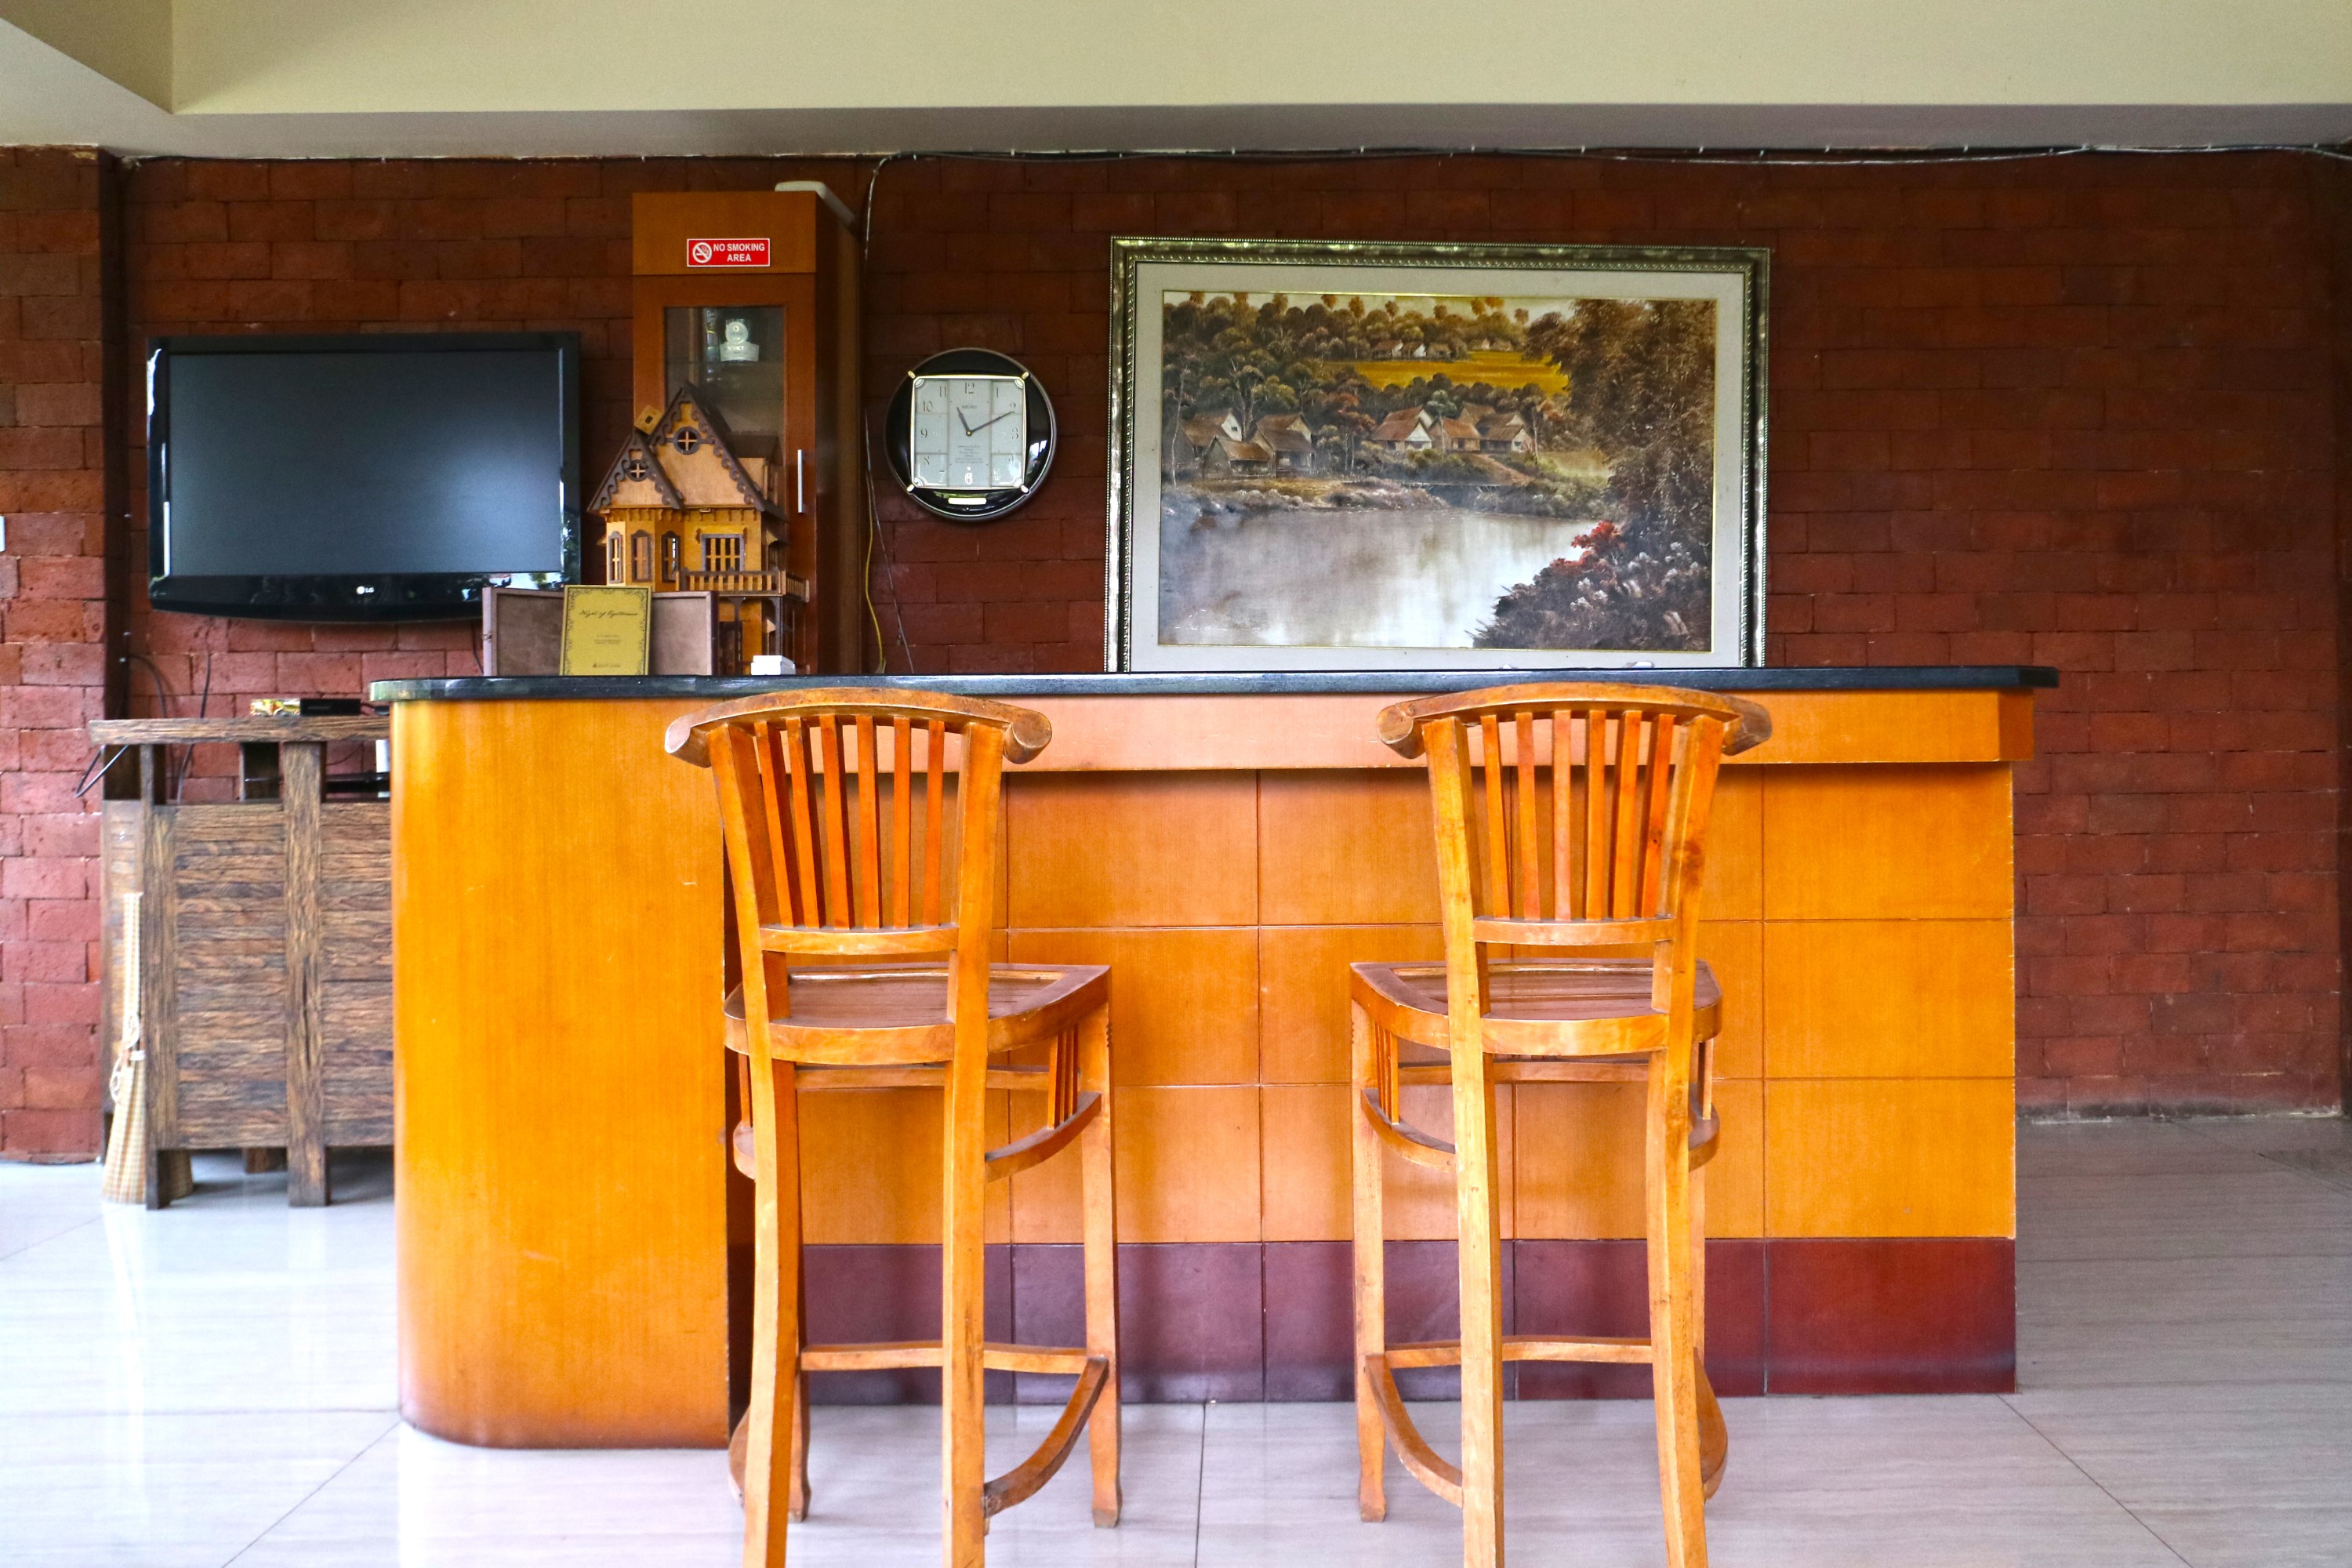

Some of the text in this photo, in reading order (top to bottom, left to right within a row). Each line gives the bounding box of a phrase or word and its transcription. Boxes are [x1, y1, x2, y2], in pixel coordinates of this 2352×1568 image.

[713, 243, 725, 252] NO
[727, 253, 752, 262] AREA
[939, 386, 947, 397] 11
[964, 382, 975, 394] 12
[923, 401, 933, 412] 10
[920, 428, 928, 438] 9
[1011, 427, 1019, 440] 3
[924, 456, 930, 466] 8
[939, 470, 946, 482] 7
[964, 472, 974, 485] 6
[993, 469, 1001, 481] 5
